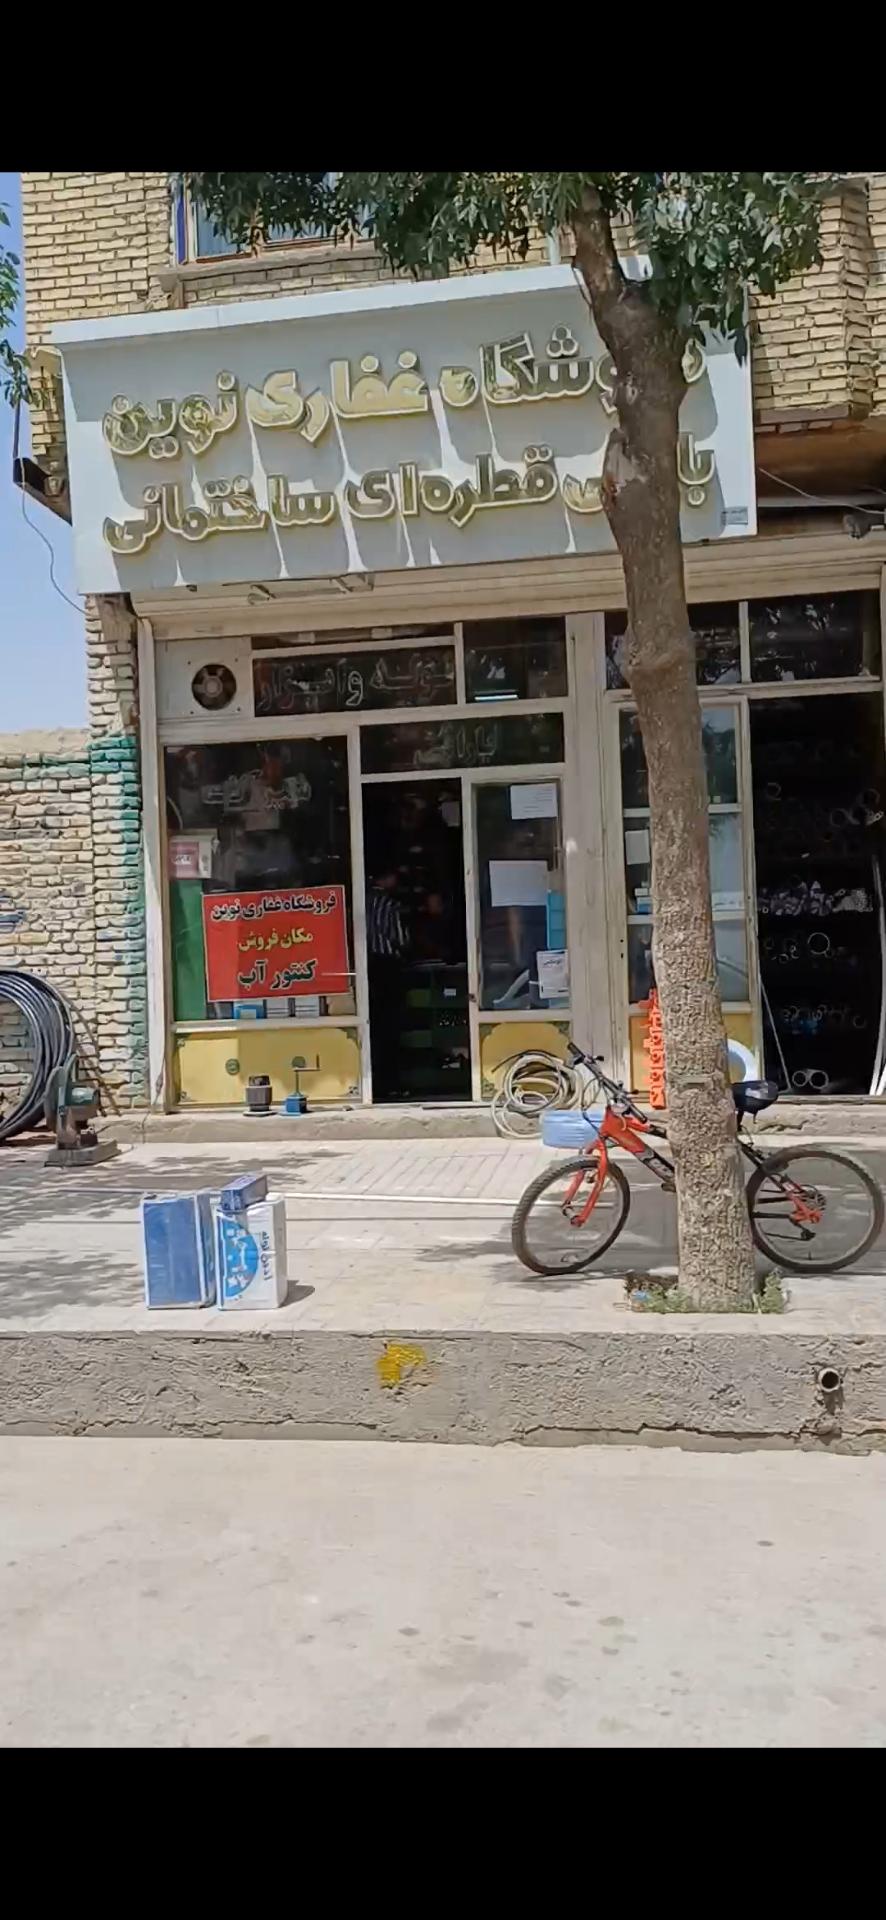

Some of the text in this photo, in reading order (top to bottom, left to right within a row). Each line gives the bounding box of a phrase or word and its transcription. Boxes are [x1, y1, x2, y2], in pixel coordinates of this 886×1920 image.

[102, 324, 706, 459] وشگاه غفاری نوین
[103, 473, 336, 554] ساختمانی
[211, 890, 337, 921] فروشگاه غفاری نوین
[237, 928, 314, 951] مکان فروش
[237, 958, 318, 991] کنتور آب
